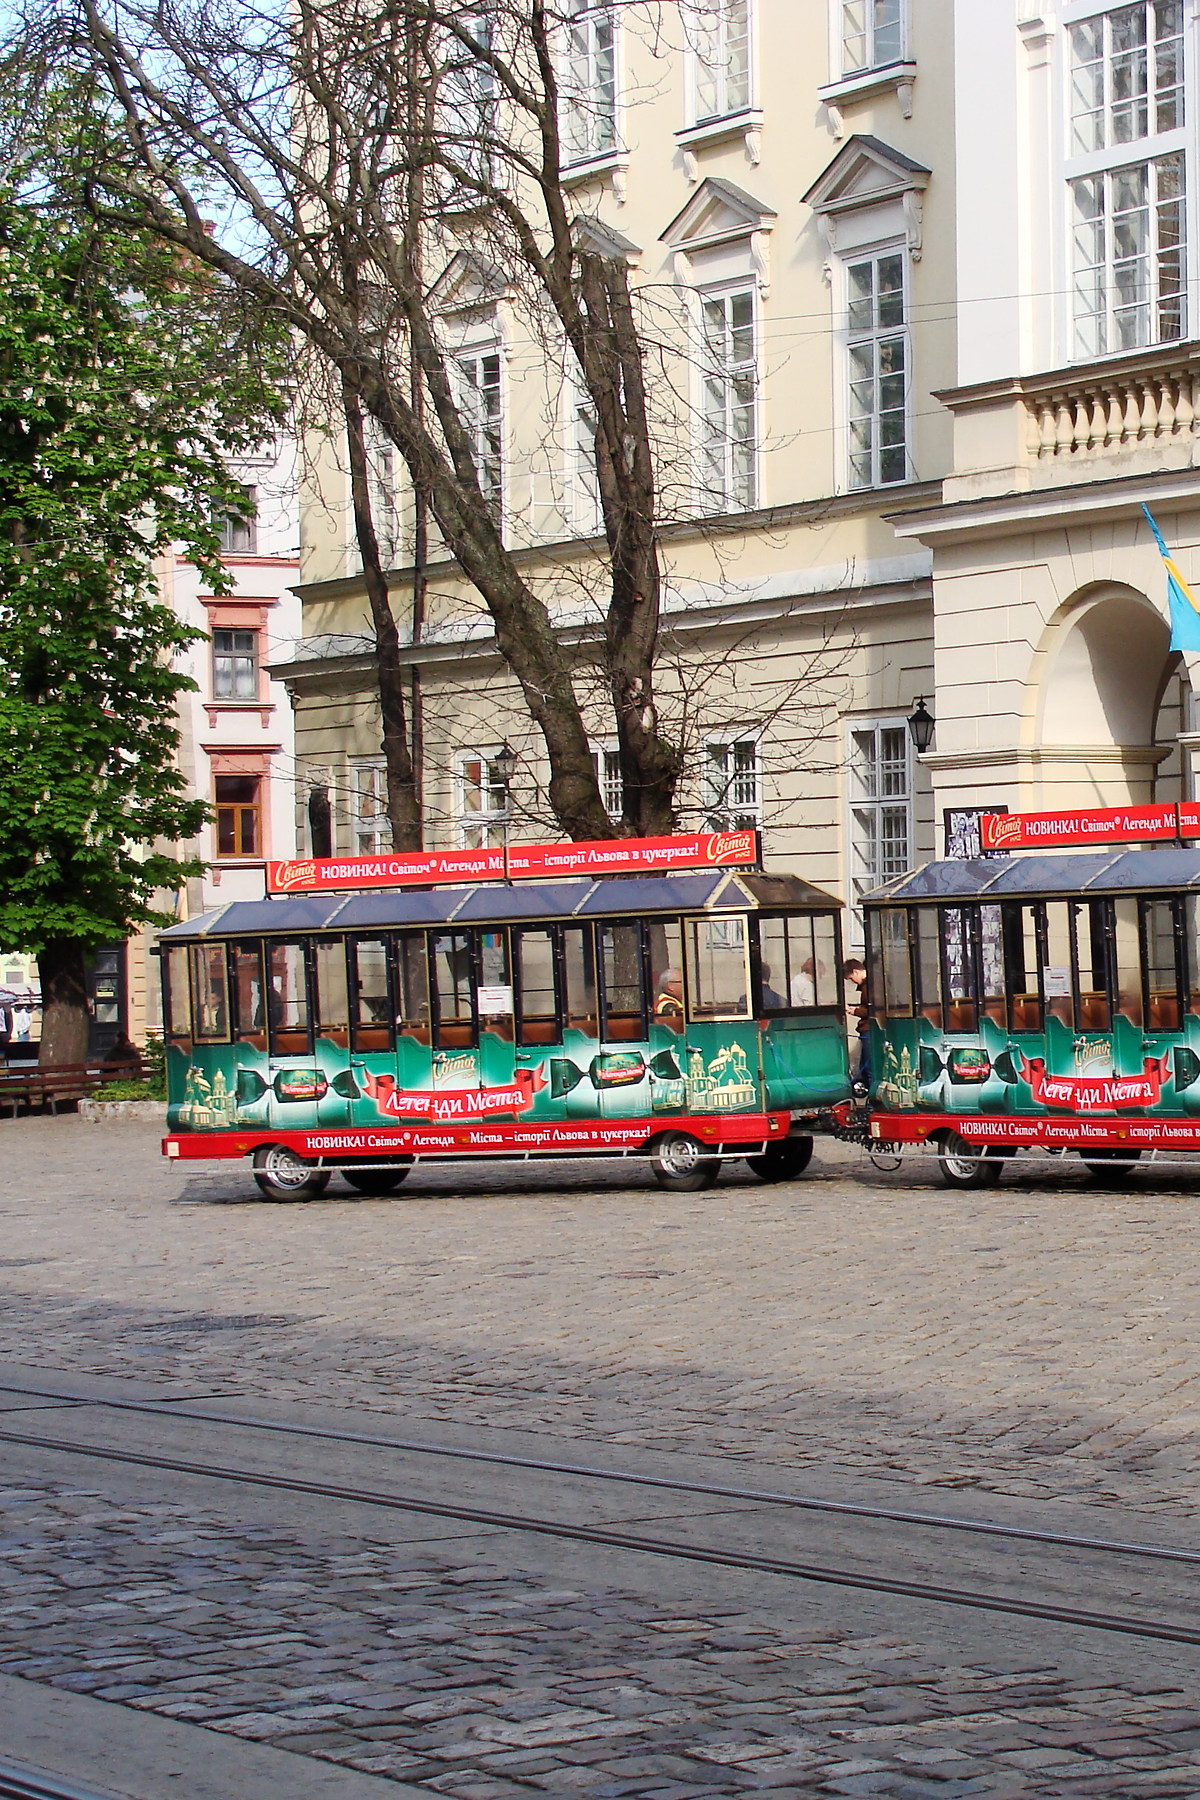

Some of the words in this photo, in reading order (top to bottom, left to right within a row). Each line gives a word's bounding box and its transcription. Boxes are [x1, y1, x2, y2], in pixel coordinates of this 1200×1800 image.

[988, 815, 1023, 843] Світоч
[1025, 820, 1079, 836] НОВИНКА!
[1122, 816, 1162, 832] Легенди
[321, 862, 386, 879] НОВИНКА!
[439, 860, 486, 874] Легенди
[544, 850, 585, 869] історії
[587, 850, 630, 864] Львова
[632, 850, 639, 861] в
[642, 842, 699, 863] цукерках!
[706, 832, 752, 861] Світоч
[275, 860, 317, 888] Світоч
[1074, 1036, 1112, 1067] Світоч
[433, 1052, 477, 1081] Світоч
[386, 1091, 464, 1119] Легенди
[465, 1090, 526, 1113] Міста
[1038, 1077, 1102, 1109] Легенди
[1103, 1082, 1154, 1103] Міста
[306, 1135, 365, 1149] НОВИНКА!
[413, 1134, 455, 1147] Легенди
[469, 1132, 503, 1144] Міста
[514, 1130, 551, 1144] історії
[552, 1129, 590, 1141] Львова
[591, 1131, 598, 1139] в
[599, 1126, 651, 1142] цукерках!
[960, 1122, 1007, 1135] НОВИНКА!
[1045, 1124, 1079, 1139] Легенди
[1080, 1123, 1108, 1137] Міста
[1130, 1125, 1161, 1140] історії
[1162, 1124, 1193, 1137] Львова
[1195, 1128, 1200, 1137] в
